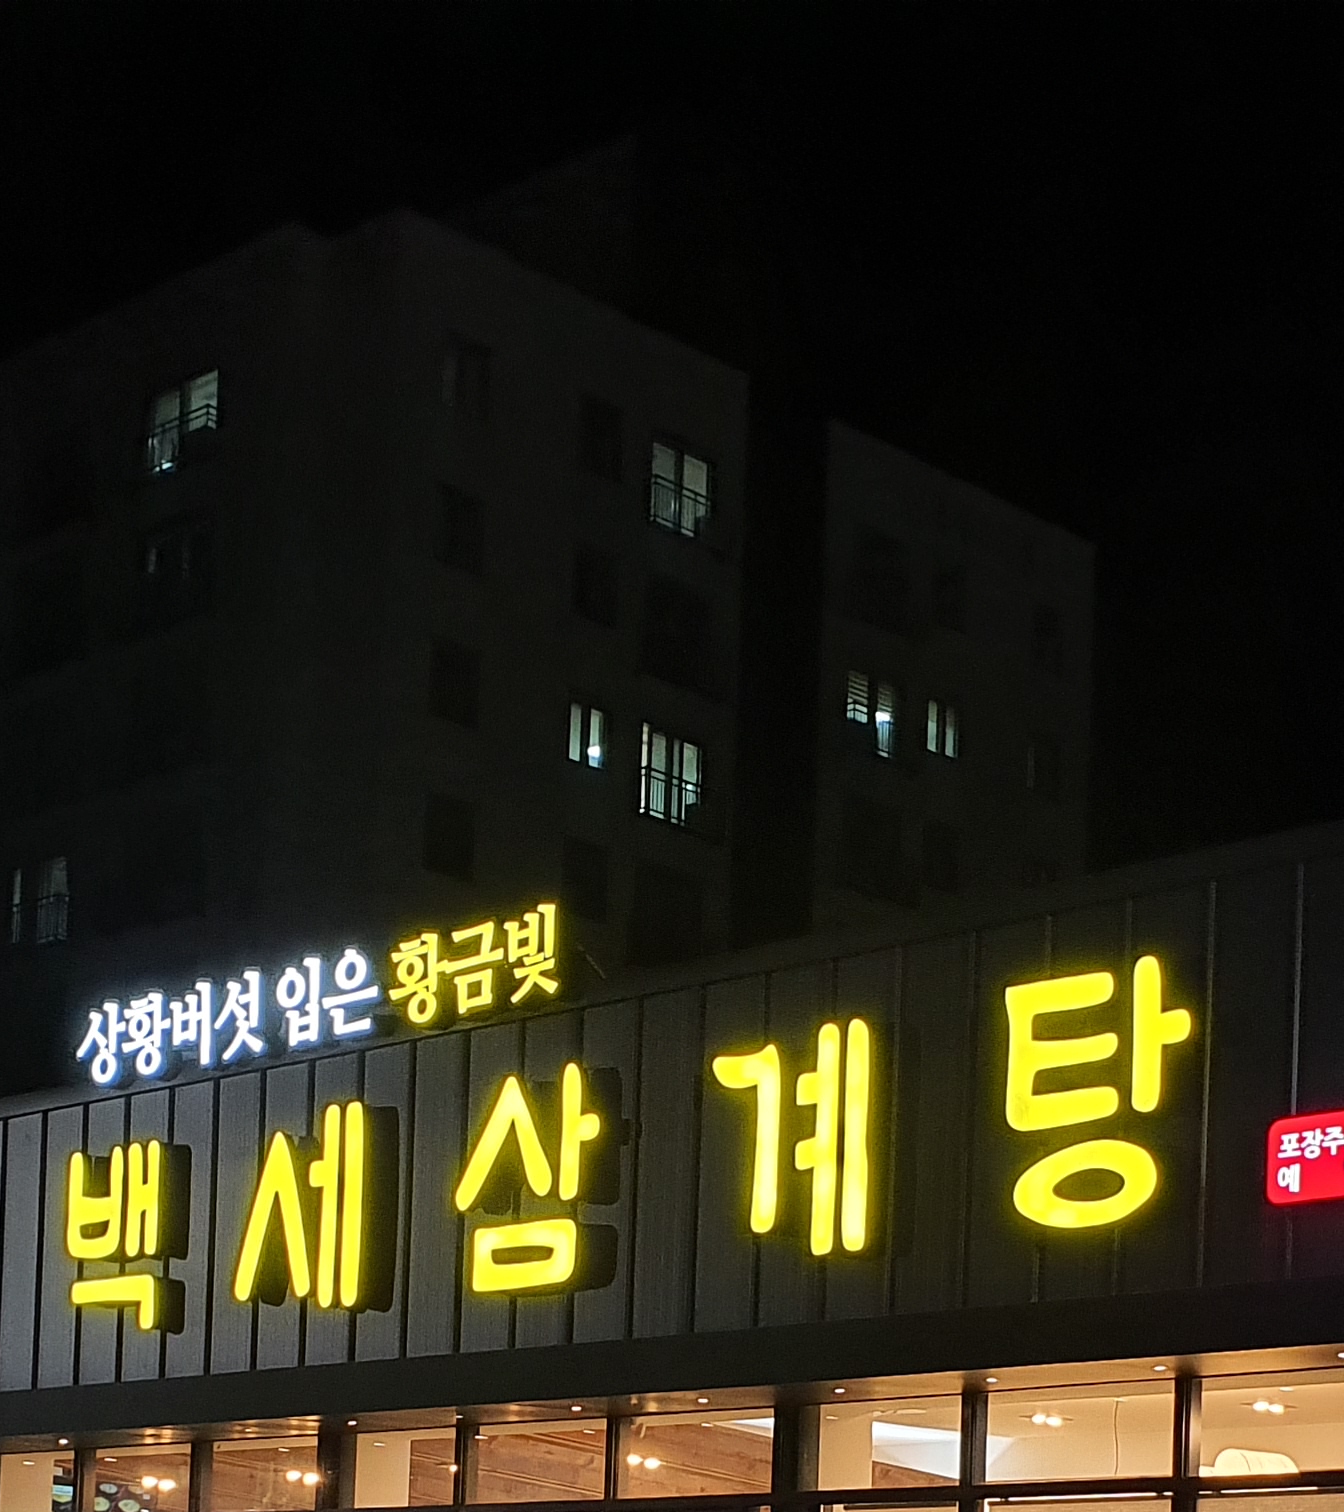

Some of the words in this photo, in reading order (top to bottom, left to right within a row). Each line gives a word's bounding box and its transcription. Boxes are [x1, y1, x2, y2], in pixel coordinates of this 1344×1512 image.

[76, 967, 265, 1084] 상황버섯
[277, 949, 378, 1047] 입은
[389, 903, 559, 1024] 황금빛
